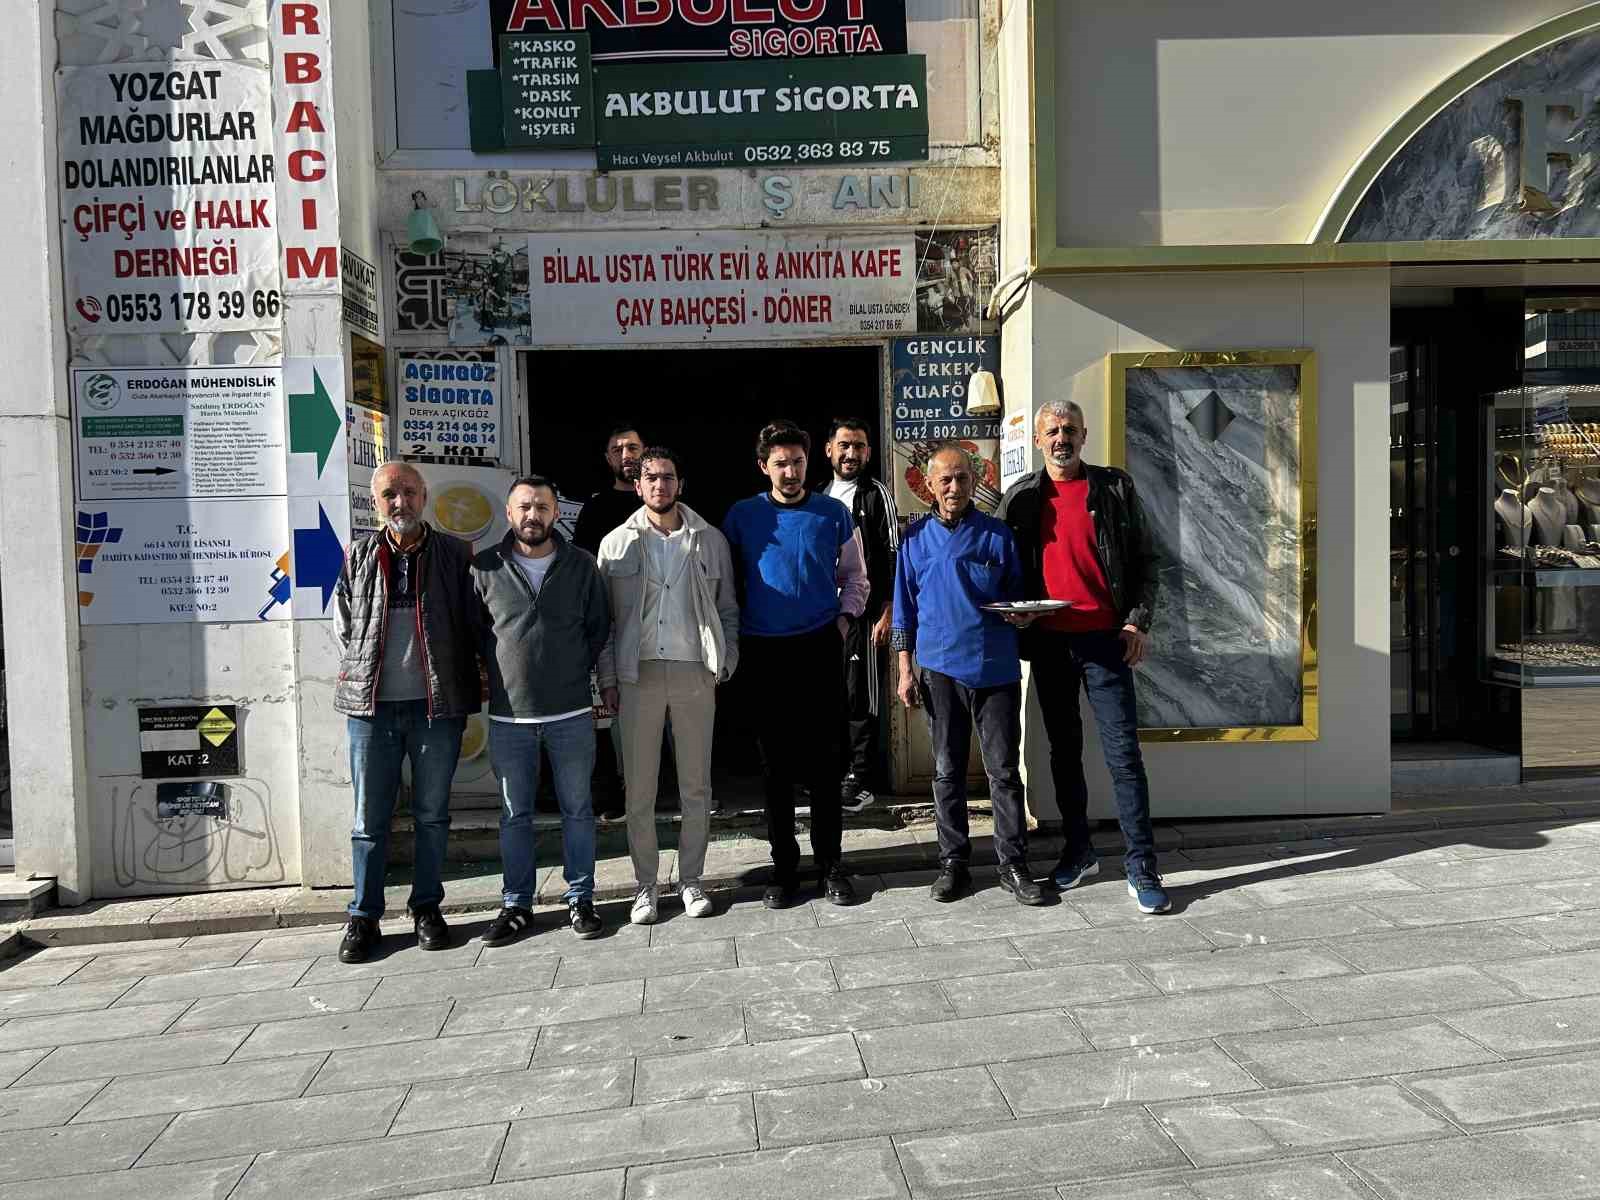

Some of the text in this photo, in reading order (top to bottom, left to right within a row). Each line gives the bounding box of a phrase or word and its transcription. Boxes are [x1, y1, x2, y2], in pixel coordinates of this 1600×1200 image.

[109, 71, 221, 103] YOZGAT
[605, 89, 765, 118] AKBULUT
[80, 108, 256, 145] MAĞDURLAR
[612, 141, 891, 167] Hacı Veysel Akbulut 0532 363 83 75
[65, 154, 274, 189] DOLANDIRILANLAR
[73, 196, 271, 242] ÇİFÇİ ve HALK
[114, 239, 238, 278] DERNEĞİ
[543, 244, 902, 283] BİLAL USTA TÜRK EVİ & ANKİTA KAFE
[343, 254, 376, 289] AVUKAT
[106, 290, 279, 321] 0553 178 39 66
[616, 298, 655, 334] ÇAY
[661, 289, 746, 333] BAHÇESİ
[764, 289, 832, 324] DÖNER
[907, 337, 986, 358] GENÇLİK
[405, 362, 495, 382] AÇIKGÖZ
[918, 362, 975, 377] ERKEK
[127, 375, 276, 389] ERDOĞAN MÜHENDİSLİK
[904, 381, 965, 400] KUAFÖ
[405, 384, 494, 406] SİGORTA
[222, 401, 264, 410] ERDOĞAN
[895, 403, 942, 419] Ömer
[403, 420, 496, 433] 0354 214 04 99
[895, 427, 927, 440] 0542
[934, 426, 957, 438] 802
[963, 425, 978, 437] 02
[403, 431, 496, 444] 0541 630 08 14
[412, 445, 487, 457] 2. KAT
[176, 524, 198, 535] T.C.
[194, 538, 231, 548] LİSANSLI
[134, 551, 178, 562] KADASTRO
[179, 549, 239, 561] MÜHENDİSLİK
[184, 576, 201, 584] 212
[204, 575, 216, 583] 87
[217, 575, 229, 583] 40
[205, 586, 216, 594] 12
[218, 586, 229, 594] 30
[195, 603, 217, 612] NO:2
[168, 754, 193, 766] KAT
